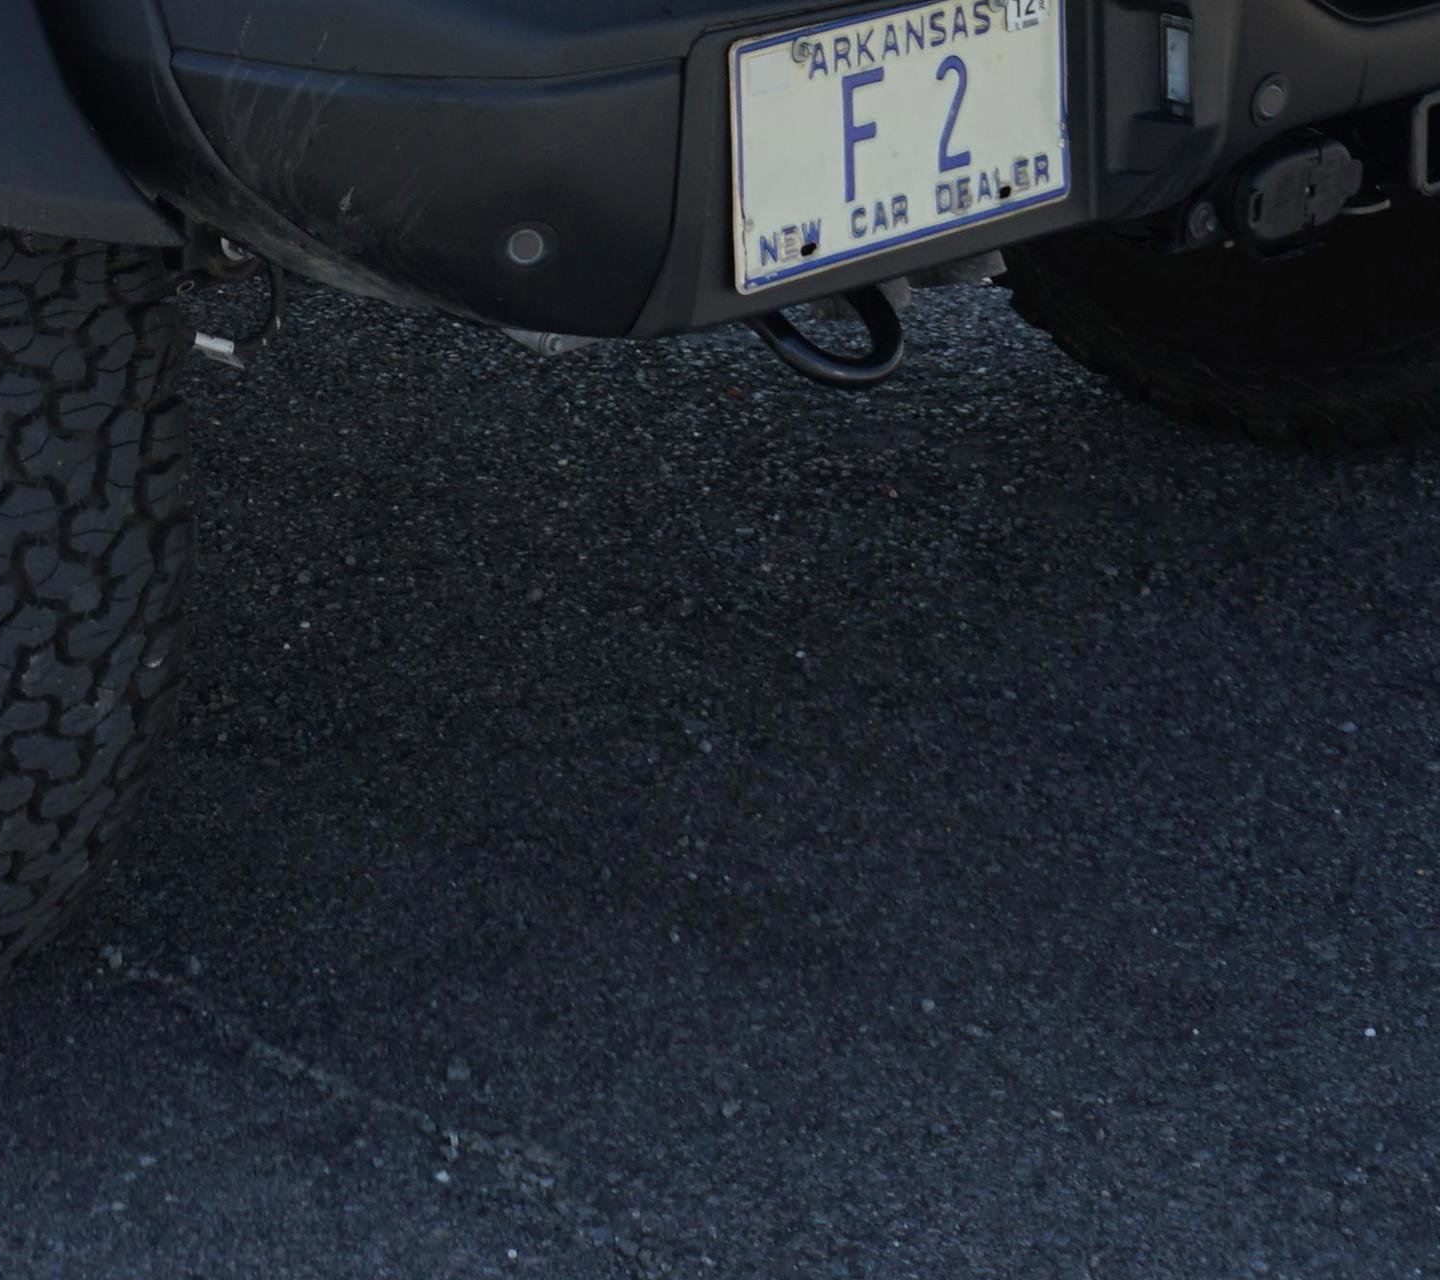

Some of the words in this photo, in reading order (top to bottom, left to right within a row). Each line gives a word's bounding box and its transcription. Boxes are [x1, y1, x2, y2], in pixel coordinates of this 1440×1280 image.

[840, 66, 885, 203] F
[934, 54, 972, 173] 2
[758, 218, 823, 267] NEW
[849, 194, 909, 239] CAR
[935, 153, 1050, 216] DEALER
